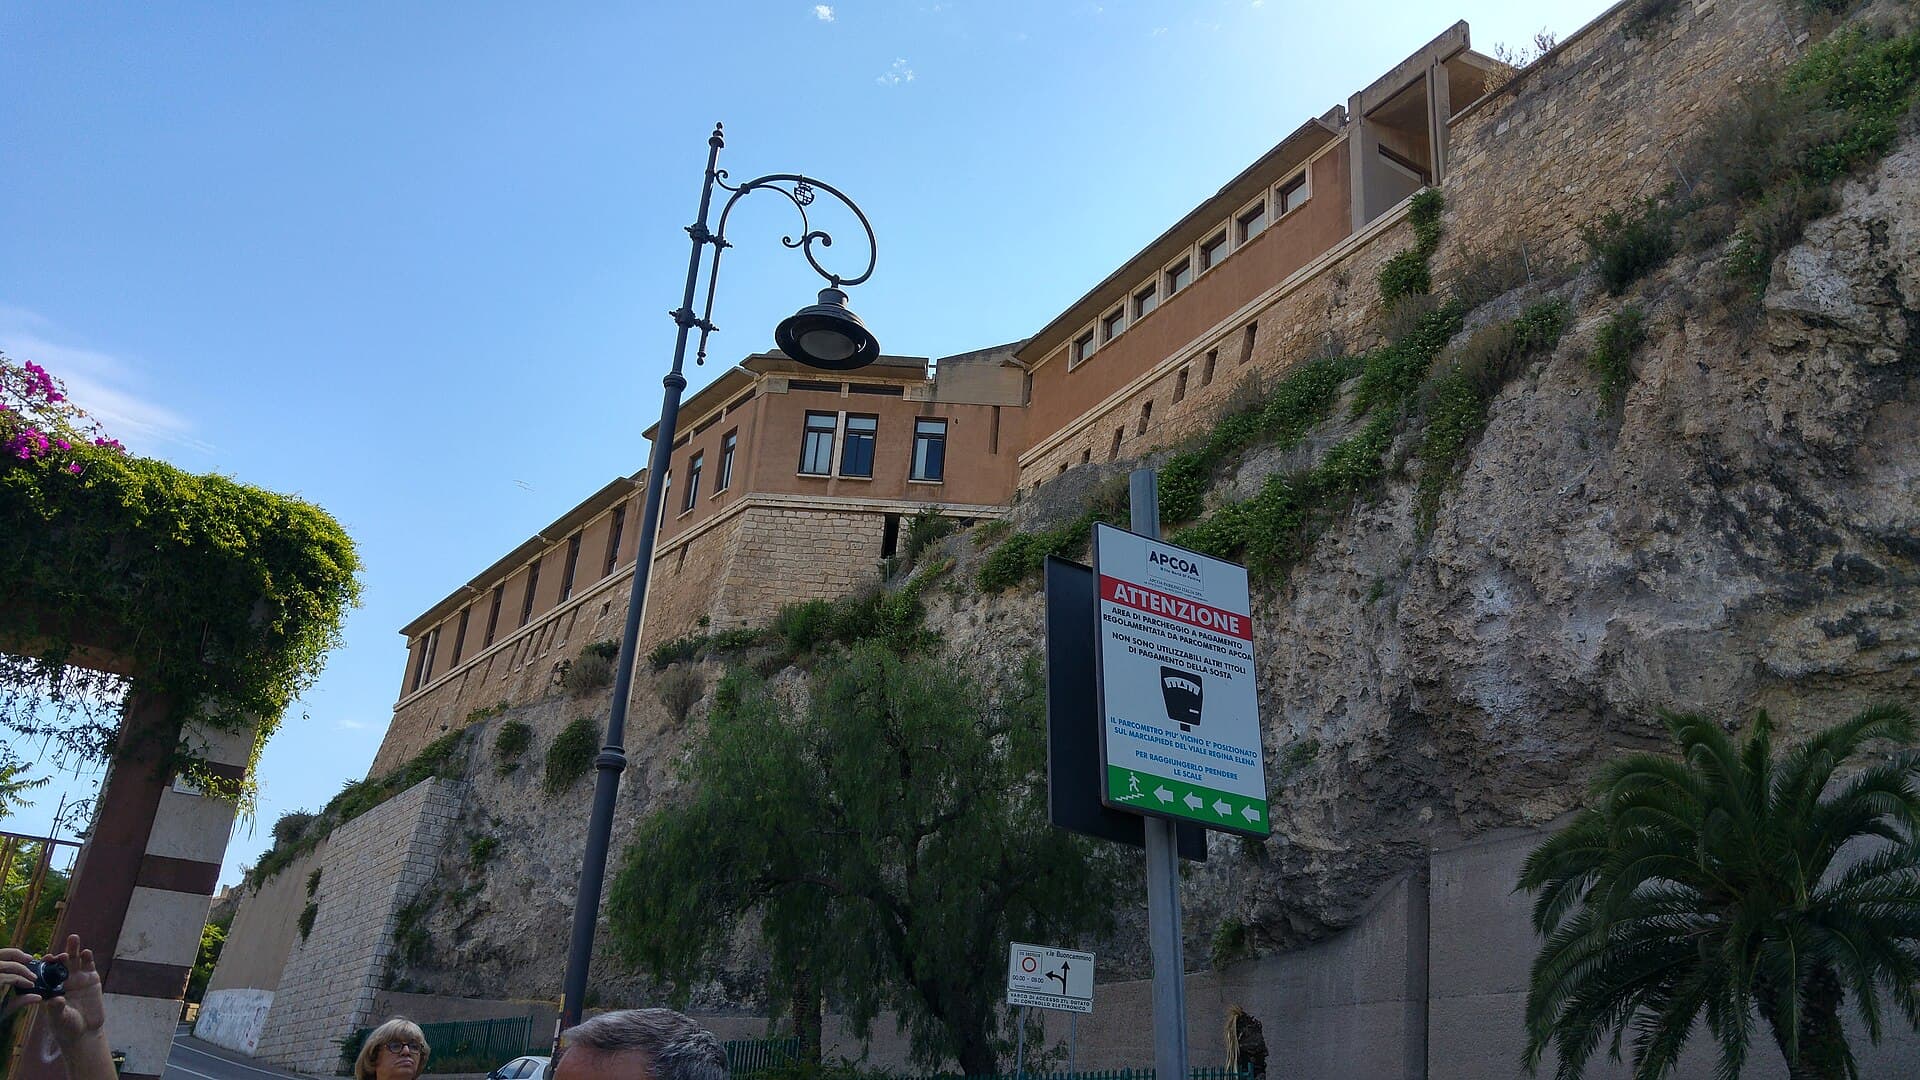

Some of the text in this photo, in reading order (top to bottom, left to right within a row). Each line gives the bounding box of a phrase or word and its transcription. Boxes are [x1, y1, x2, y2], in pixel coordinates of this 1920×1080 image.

[1149, 551, 1199, 576] APCOA
[1112, 607, 1131, 619] AREA
[1133, 612, 1141, 620] DI
[1143, 615, 1190, 635] PARCHEGGIO
[1199, 632, 1243, 649] PAGAMENTO
[1114, 584, 1240, 634] ATTENZIONE
[1104, 615, 1252, 660] REGOLAMENTATA DA PARCOMETRO APCOA
[1113, 632, 1246, 674] NON SONO UTILIZZABILI ALTRI TITOLI
[1138, 649, 1184, 667] PAGAMENTO
[1186, 662, 1208, 673] DELLA
[1210, 668, 1232, 680] SOSTA
[1114, 727, 1255, 766] SUL MARCIAPIEDE DEL VIALE REGINA ELENA
[1118, 719, 1164, 735] PARCOMETRO
[1165, 730, 1179, 738] PIU'
[1180, 734, 1204, 746] VICINO
[1213, 742, 1258, 758] POSIZIONATO
[1136, 750, 1238, 780] PER RAGGIUNGERLO PRENDERE
[1182, 770, 1202, 780] SCALE
[1021, 999, 1050, 1007] CONTROLLO
